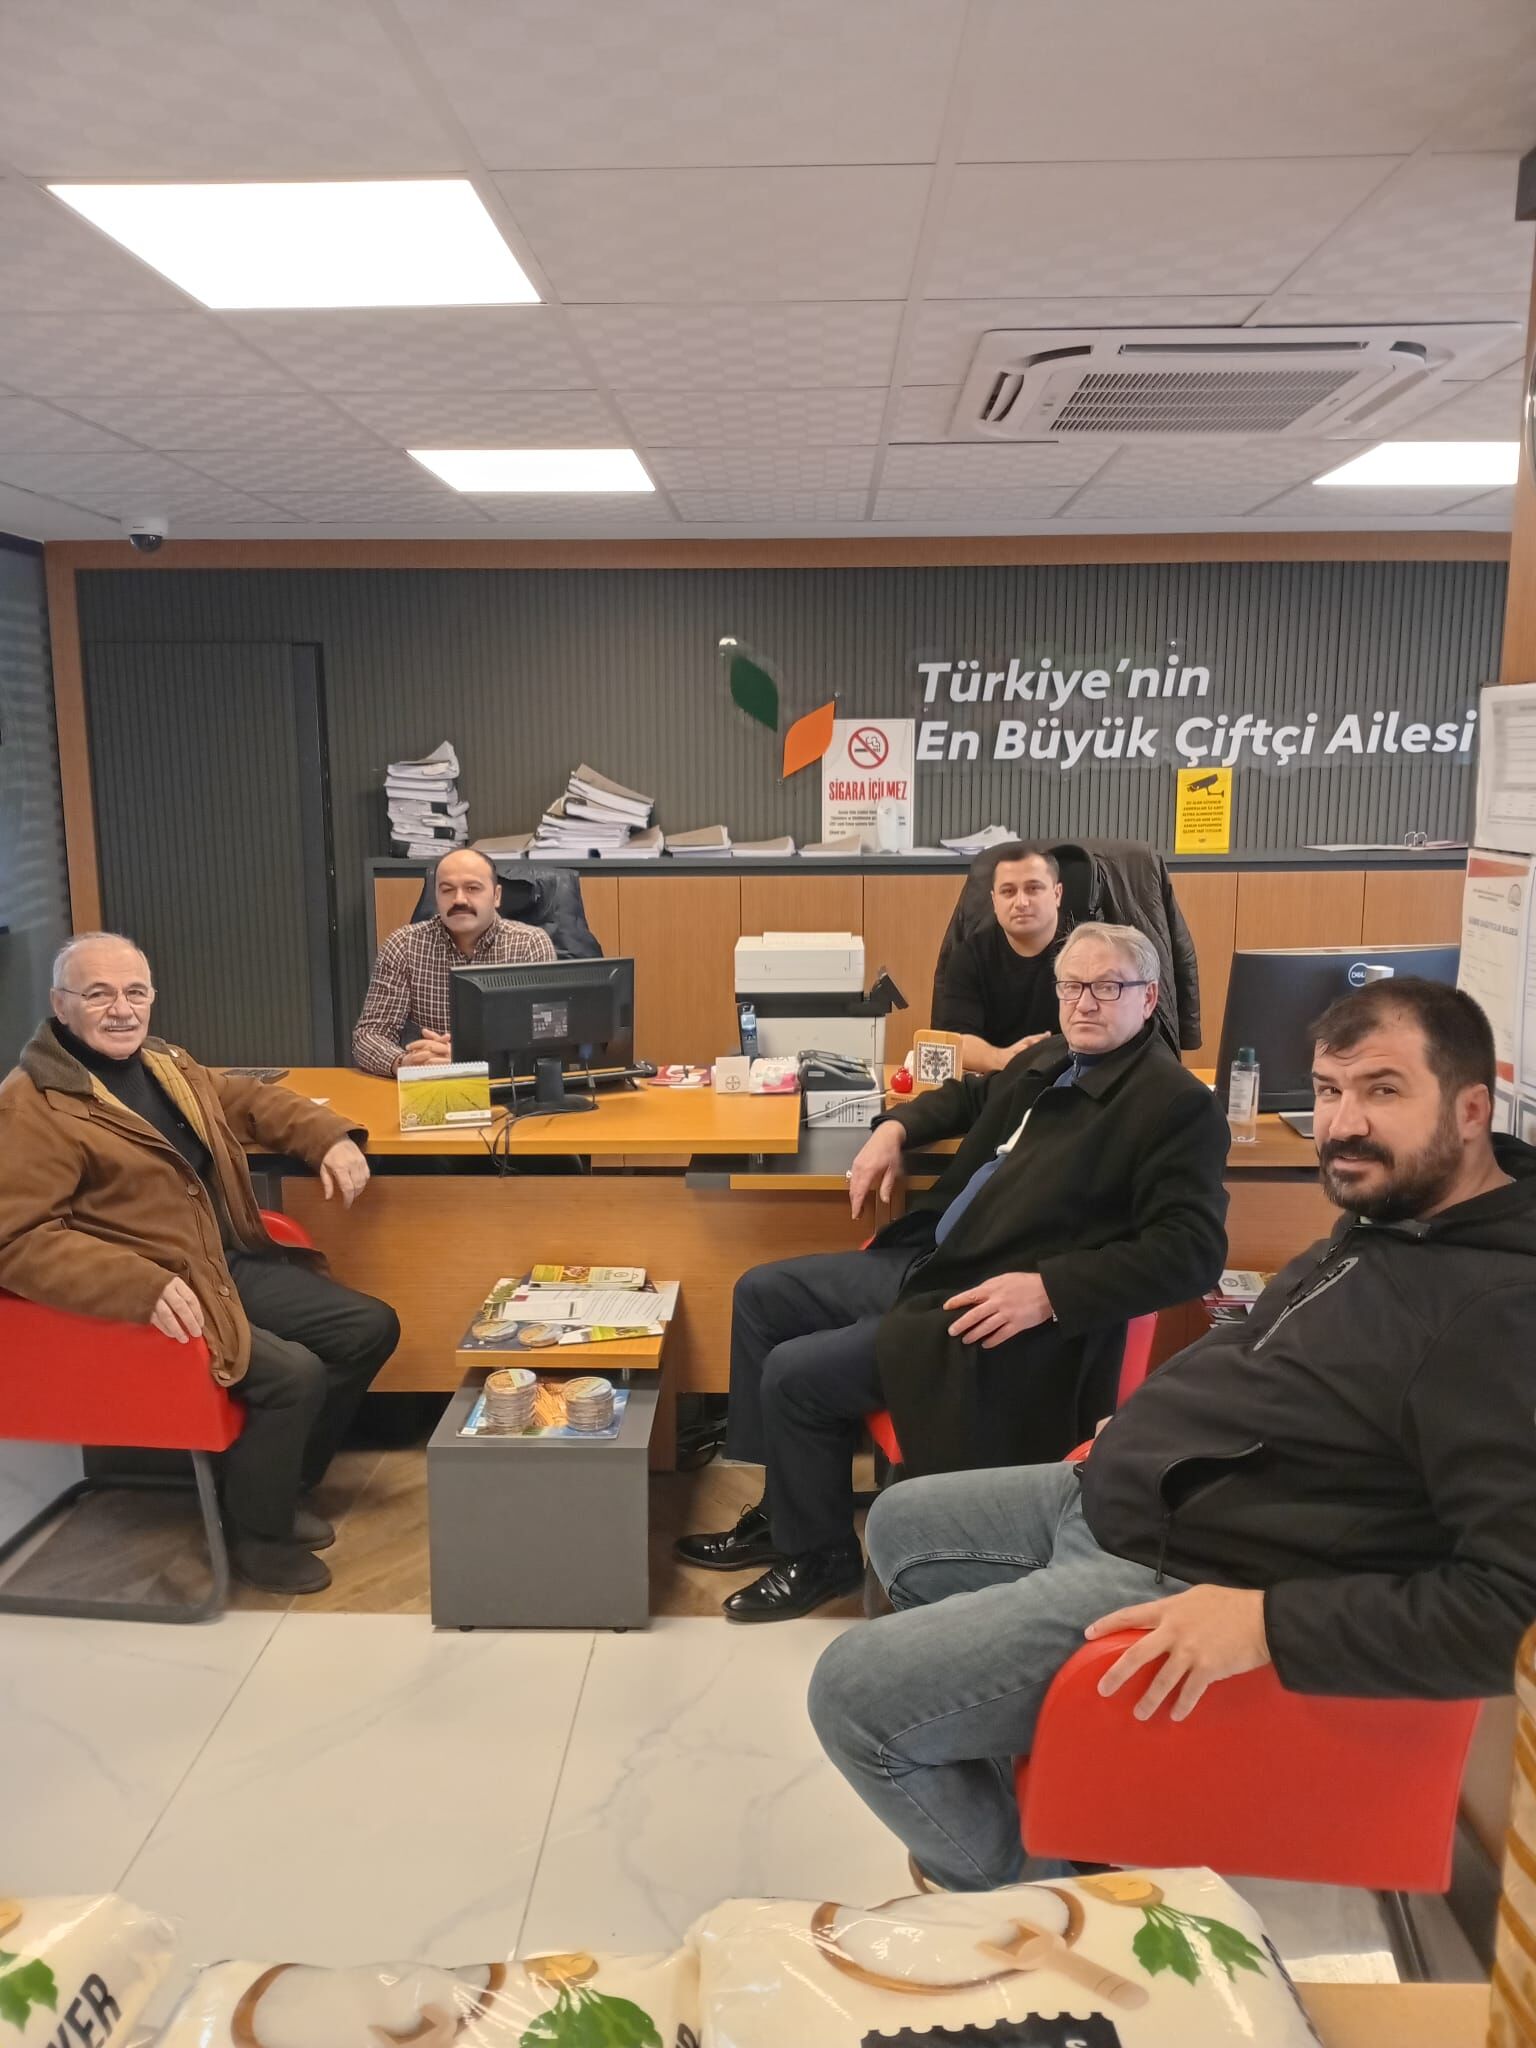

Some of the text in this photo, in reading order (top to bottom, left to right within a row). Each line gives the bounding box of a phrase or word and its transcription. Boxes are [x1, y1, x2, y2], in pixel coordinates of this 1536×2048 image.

[917, 655, 1210, 711] Türkiye'nin
[915, 709, 1478, 770] En Büyük Çiftçi Ailesi
[828, 778, 866, 801] SİGARA
